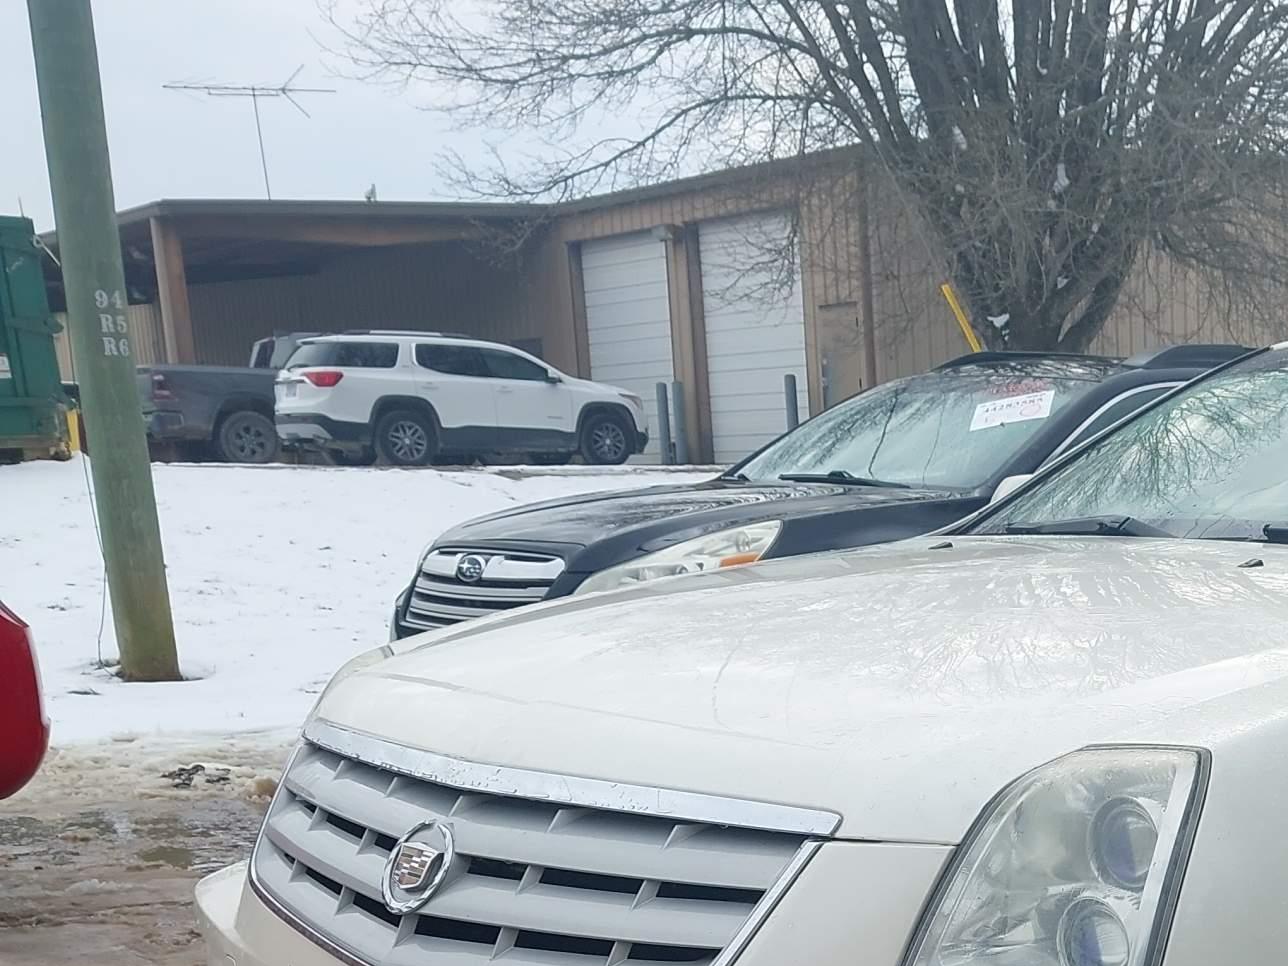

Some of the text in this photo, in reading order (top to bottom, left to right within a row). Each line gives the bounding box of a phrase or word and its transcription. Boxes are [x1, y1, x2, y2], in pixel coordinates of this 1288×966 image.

[94, 289, 123, 309] 94
[99, 313, 128, 334] R5
[101, 337, 129, 357] R6
